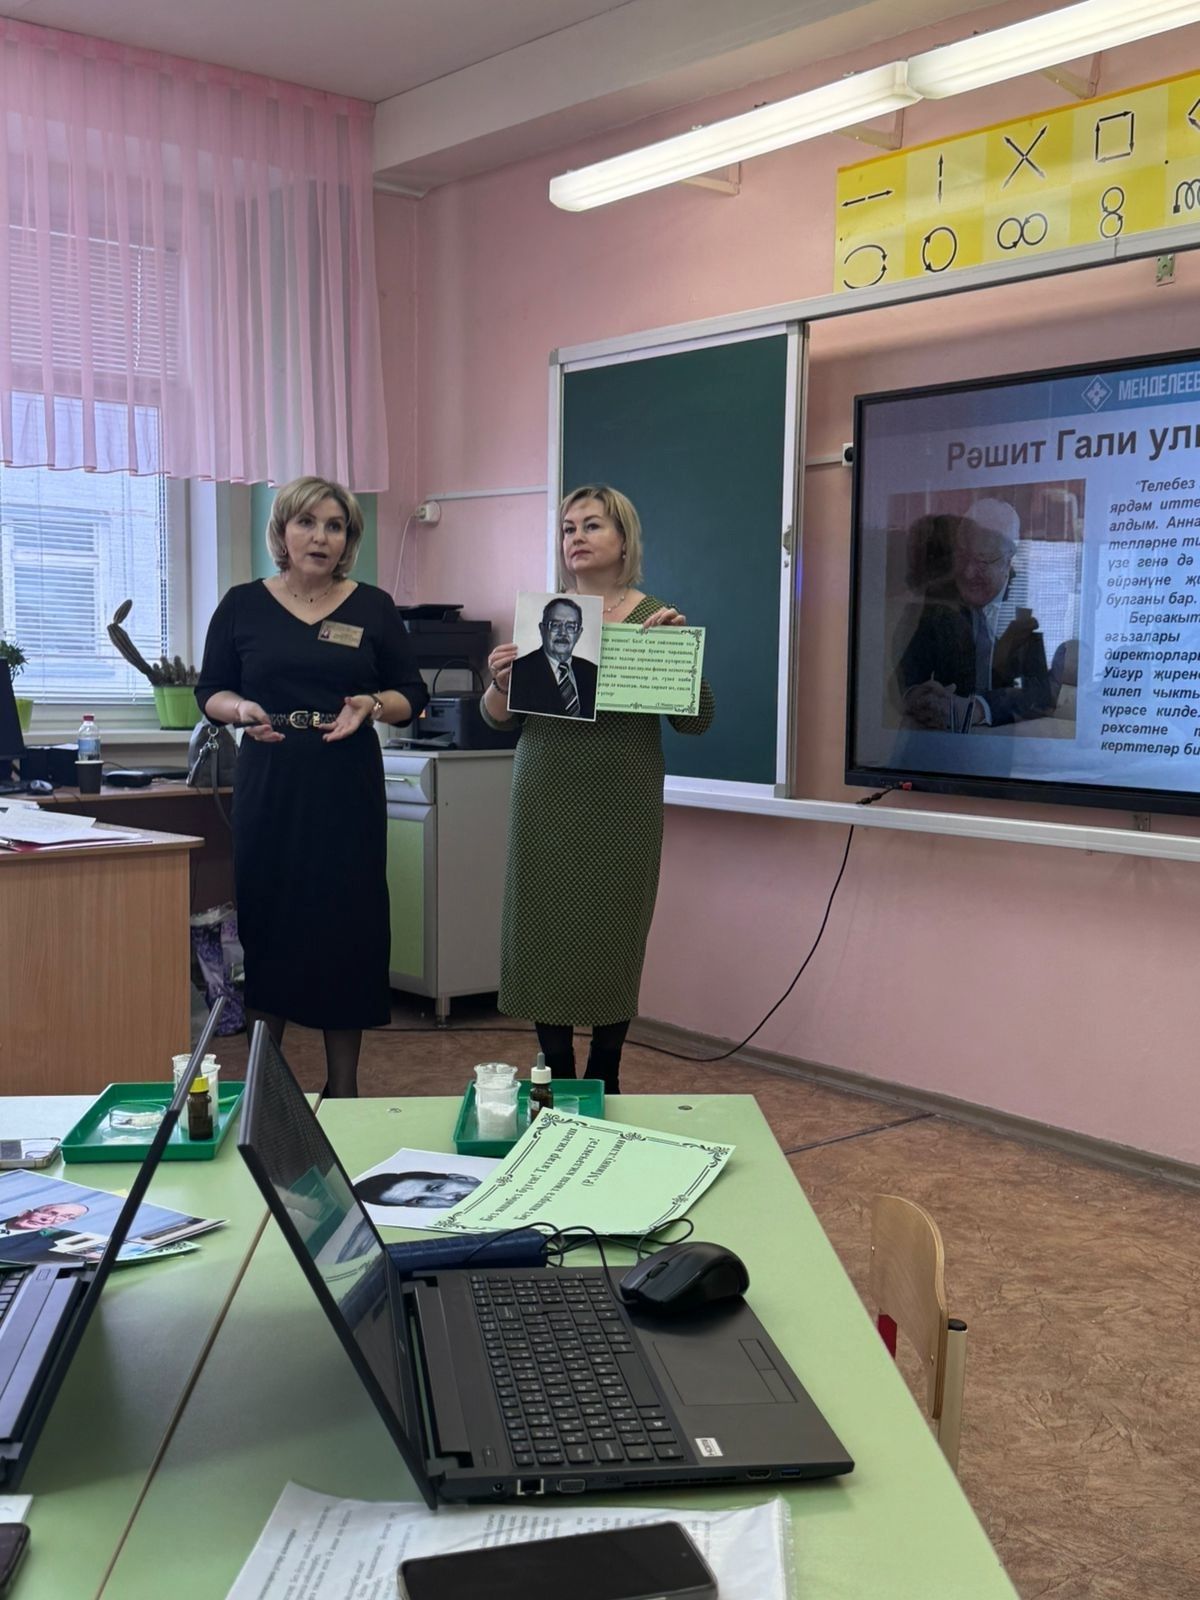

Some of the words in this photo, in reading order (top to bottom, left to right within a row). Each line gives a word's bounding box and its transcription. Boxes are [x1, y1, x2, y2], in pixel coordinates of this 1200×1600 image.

[947, 440, 1047, 471] Рәшит
[1056, 429, 1137, 461] Гали
[1109, 499, 1152, 516] ярдәм
[1109, 518, 1159, 532] алдым.
[1108, 537, 1177, 552] телләрне
[1137, 557, 1168, 568] генә
[1177, 553, 1194, 566] дә
[1107, 575, 1171, 590] өйрәнүне
[1106, 593, 1165, 609] булганы
[1168, 592, 1197, 607] бар.
[1104, 632, 1180, 645] әгъзалары
[1103, 666, 1143, 682] Уйгур
[1153, 670, 1200, 682] җирен
[1102, 687, 1142, 698] килеп
[1102, 704, 1147, 718] күрәсе
[1100, 723, 1168, 736] рөхсәтне
[1100, 741, 1180, 757] керттеләр
[533, 1152, 560, 1173] Татар
